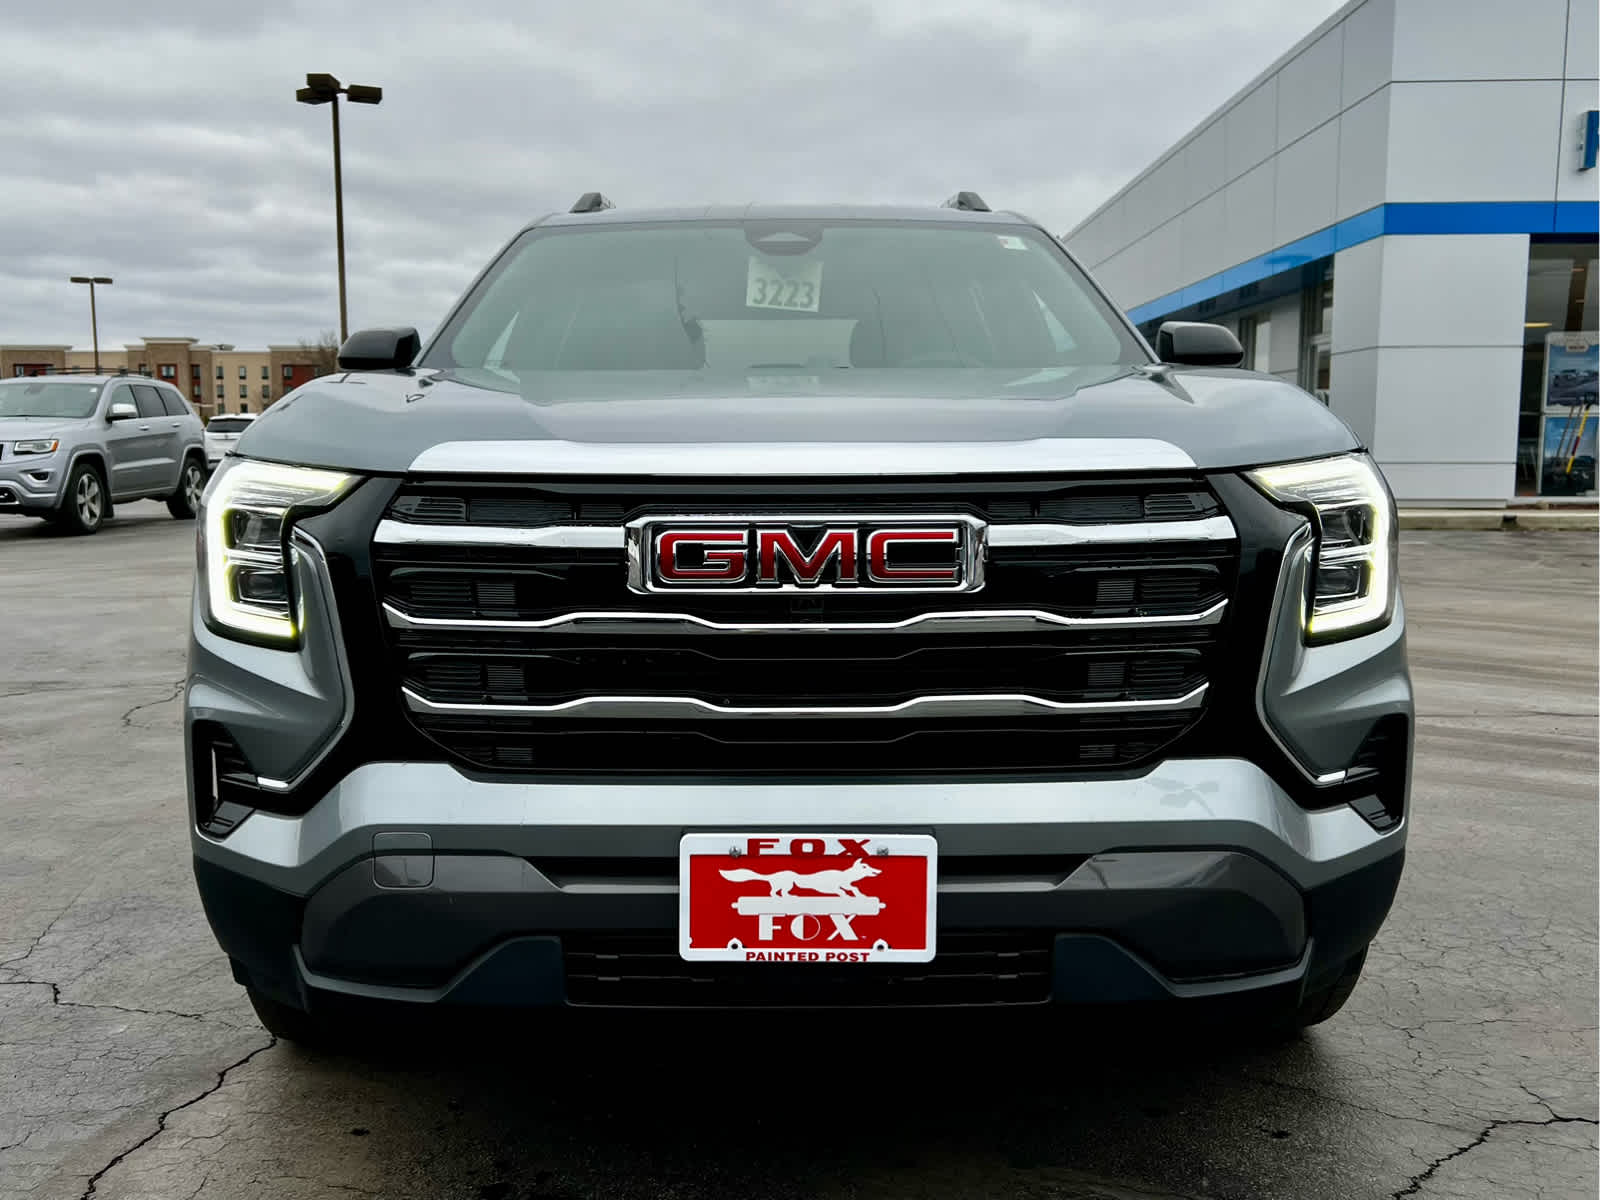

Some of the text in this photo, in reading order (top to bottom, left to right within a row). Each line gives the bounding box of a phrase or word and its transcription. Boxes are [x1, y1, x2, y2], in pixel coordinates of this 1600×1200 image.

[752, 278, 815, 308] 3223
[656, 528, 959, 585] GMC
[747, 838, 871, 856] FOX
[758, 913, 859, 941] FOX
[745, 952, 870, 962] PAINTED POST
